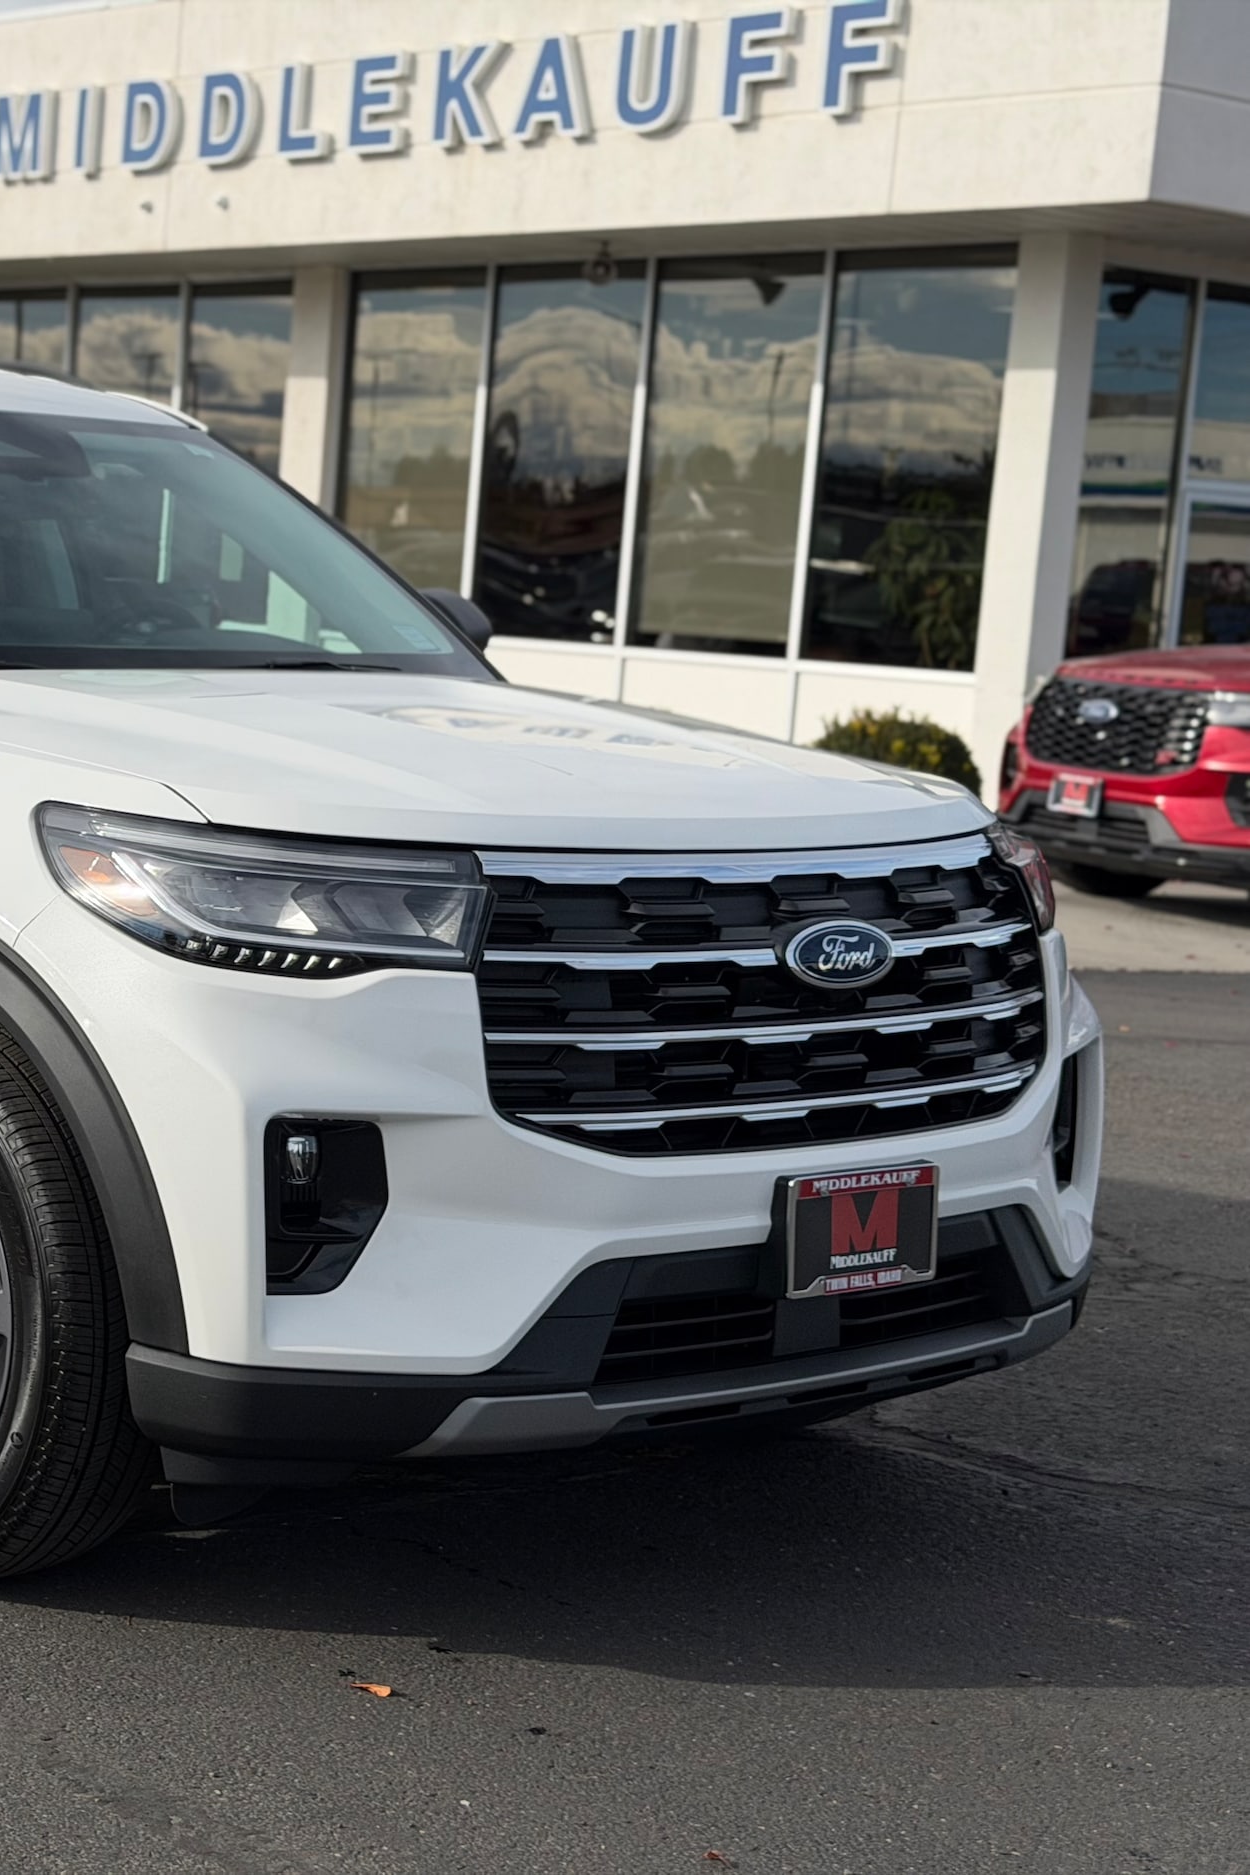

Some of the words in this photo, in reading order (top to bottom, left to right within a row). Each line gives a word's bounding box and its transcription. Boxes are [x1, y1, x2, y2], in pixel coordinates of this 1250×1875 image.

[818, 934, 876, 971] Ford
[831, 1190, 898, 1254] M
[829, 1248, 897, 1269] MIDDLEKAUFF
